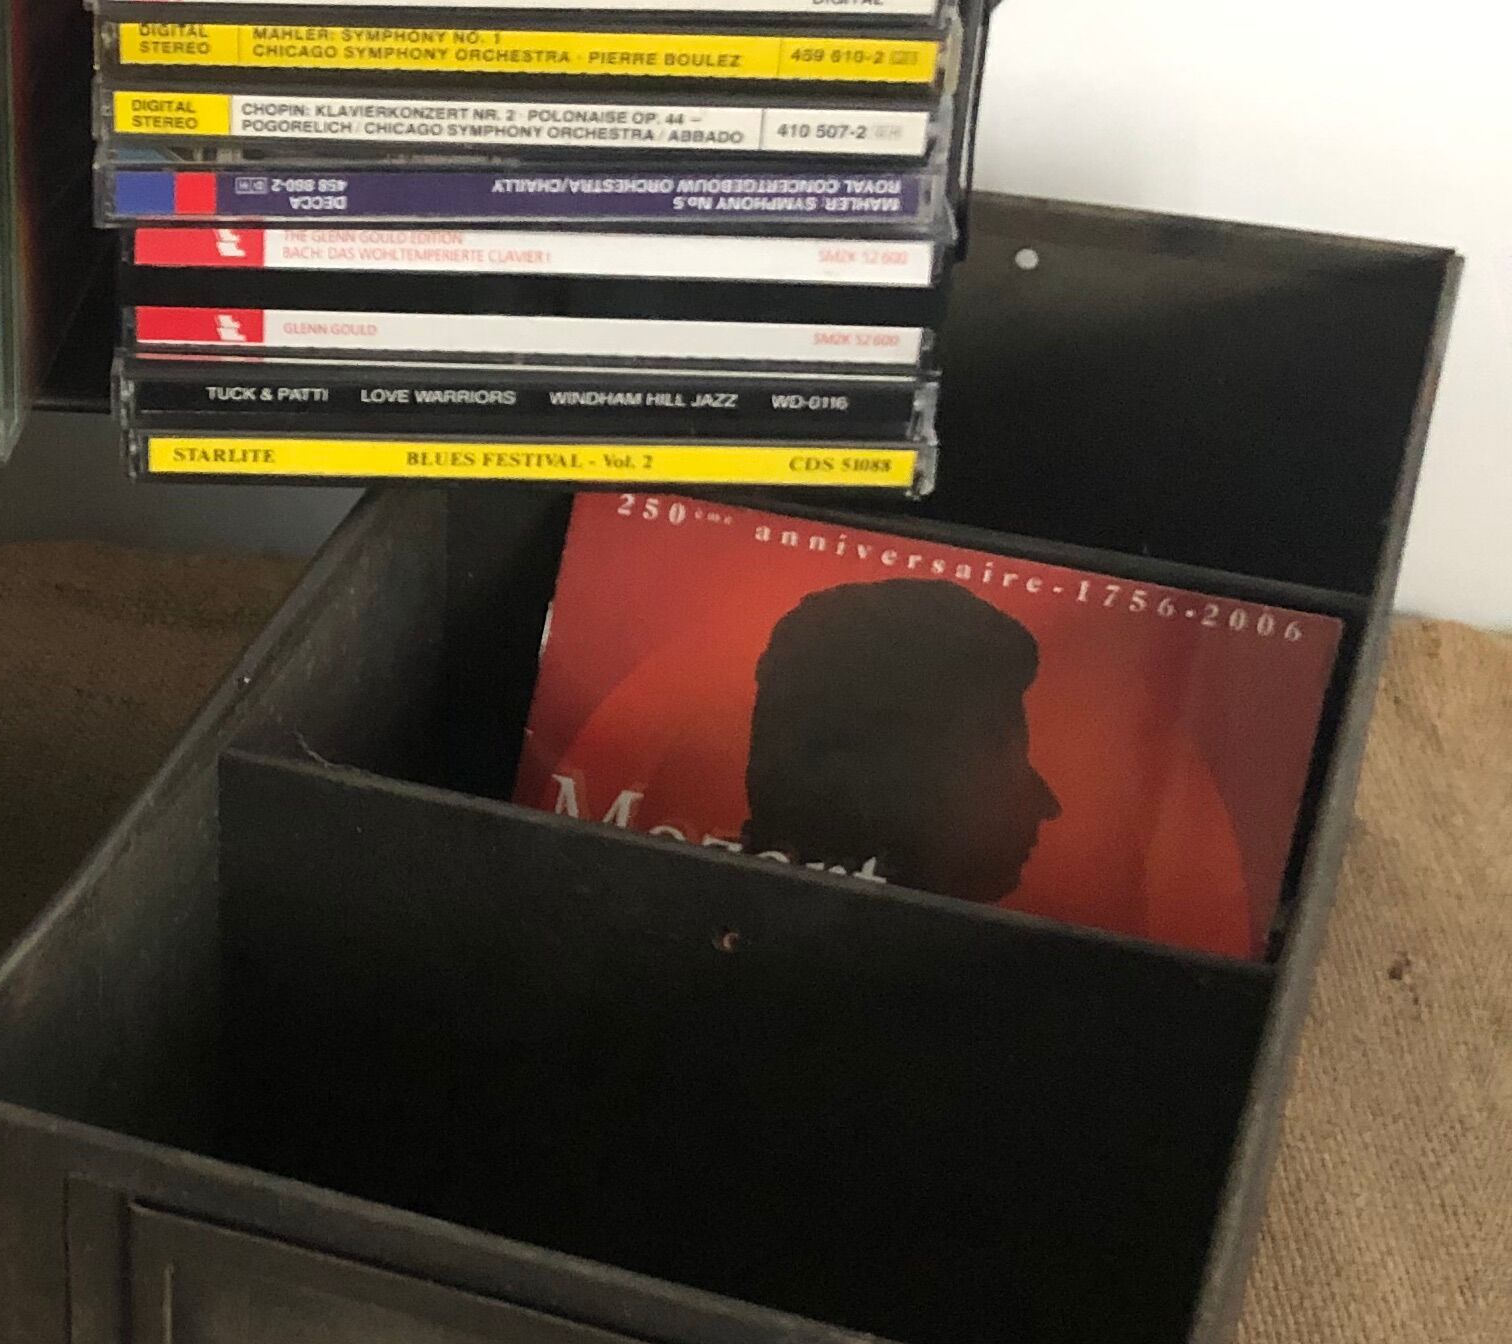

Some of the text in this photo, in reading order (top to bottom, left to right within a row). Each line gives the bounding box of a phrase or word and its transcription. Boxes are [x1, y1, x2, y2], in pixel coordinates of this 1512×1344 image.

[138, 23, 209, 39] DIGITAL
[251, 26, 502, 46] MAHLER: SYMPHONY NO. 1
[138, 39, 212, 56] STEREO
[251, 43, 743, 69] CHICAGO SYMPHONY ORCHESTRA PIERRE BOULEZ
[790, 47, 826, 64] 459
[130, 98, 197, 115] DIGITAL
[241, 102, 686, 126] CHOPIN: KLAVIERKONZERT NR. 2 POLONAISE OP. 44
[131, 115, 199, 131] STEREO
[241, 118, 745, 145] POGORELICH CHICAGO SYMPHONY ORCHESTRA ABBADO
[776, 123, 869, 141] 410 507-2
[317, 178, 349, 193] 458
[492, 177, 902, 195] ROYAL CONCERTGEBOUW ORCHESTRA/CHAILLY
[288, 195, 349, 211] DECCA
[715, 196, 819, 211] SYMPHONY
[311, 230, 357, 244] GLENN
[359, 231, 408, 245] GOULD
[410, 231, 465, 246] EDITION
[282, 246, 545, 265] BACH: DAS WOHLTEMPERIERTE CLAVIER
[282, 323, 378, 337] GLENN GOULD
[813, 332, 852, 347] SM2K
[855, 333, 872, 347] 52
[205, 385, 330, 403] TUCK & PATTI
[359, 387, 517, 406] LOVE WARRIORS
[548, 390, 739, 408] WINDHAM HILL JAZZ
[172, 446, 276, 464] STARLITE
[405, 451, 654, 470] BLUES FESTIVAL Vol. 2
[788, 455, 892, 473] CDS 51088
